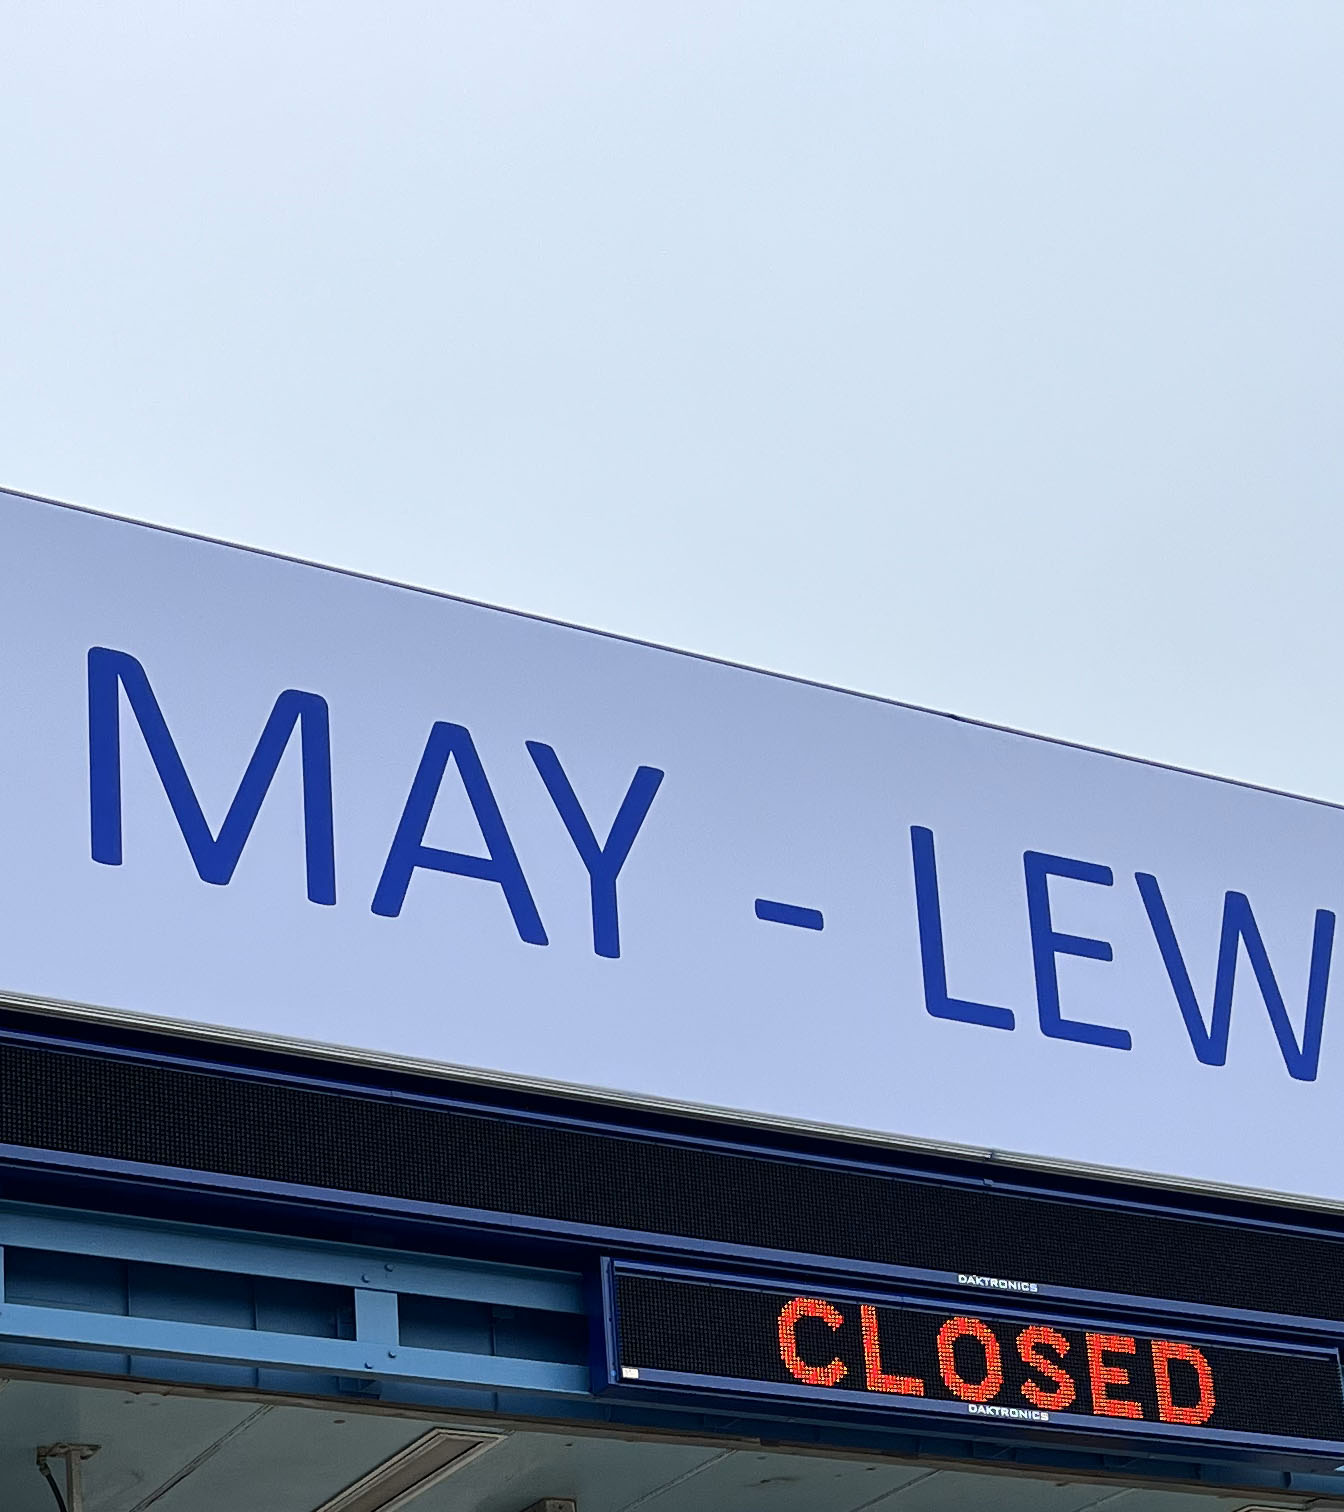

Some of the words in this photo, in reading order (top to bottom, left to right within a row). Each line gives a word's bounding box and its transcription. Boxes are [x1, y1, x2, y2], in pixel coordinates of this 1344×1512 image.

[88, 647, 665, 959] MAY
[755, 898, 823, 930] -
[958, 1274, 1038, 1292] DAKTRONICS
[777, 1296, 1216, 1425] CLOSED
[968, 1403, 1049, 1421] DAKTRONICS
